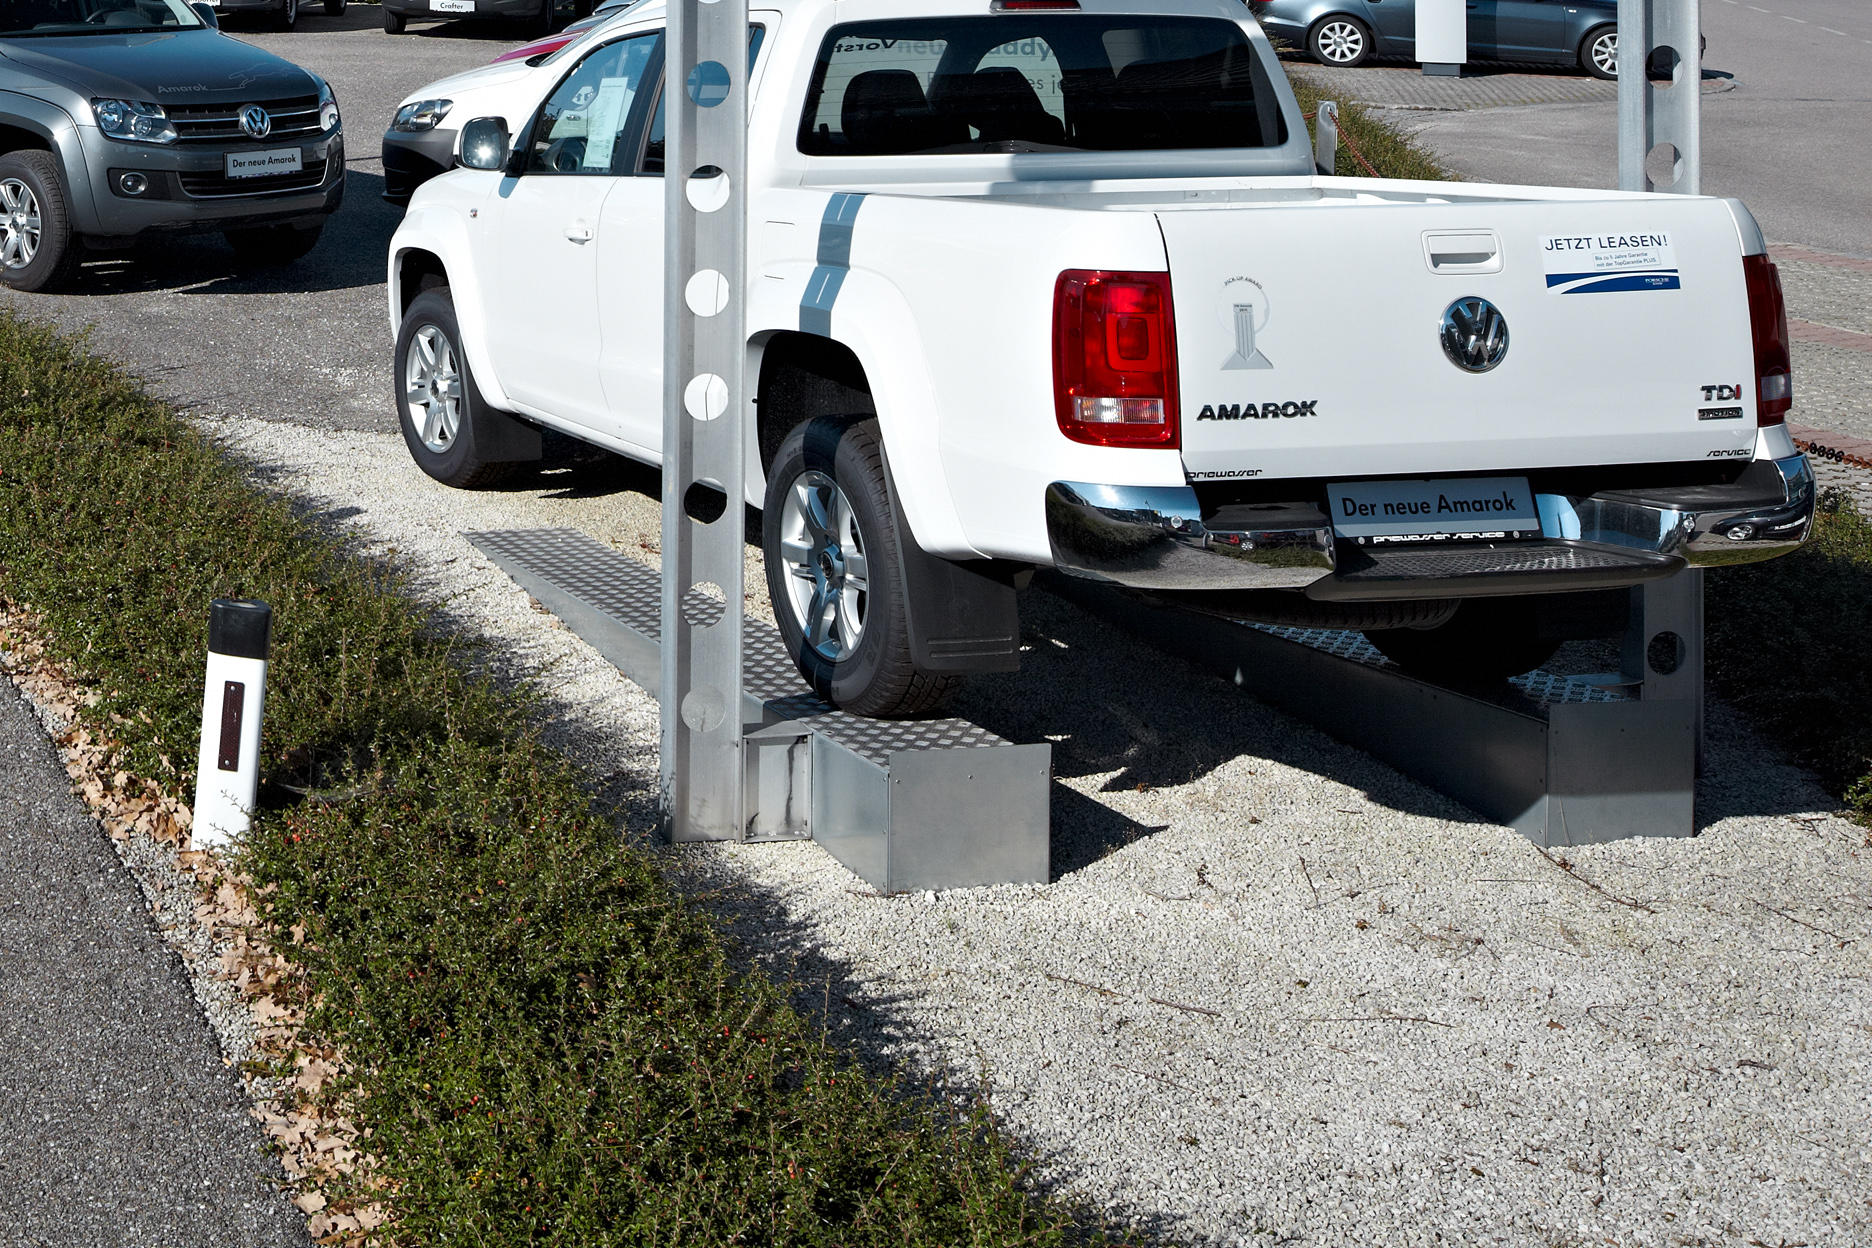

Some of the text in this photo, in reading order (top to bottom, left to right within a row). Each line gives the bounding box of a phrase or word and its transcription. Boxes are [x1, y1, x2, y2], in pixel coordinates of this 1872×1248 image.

[158, 83, 209, 94] Amarok
[232, 154, 297, 168] Der neue Amarok
[1545, 235, 1668, 250] JETZT LEASEN!
[1701, 384, 1741, 401] TDI
[1197, 400, 1318, 421] AMAROK
[1707, 448, 1751, 457] service
[1341, 491, 1516, 516] Der neue Amarok
[1373, 531, 1505, 544] priewasser service
